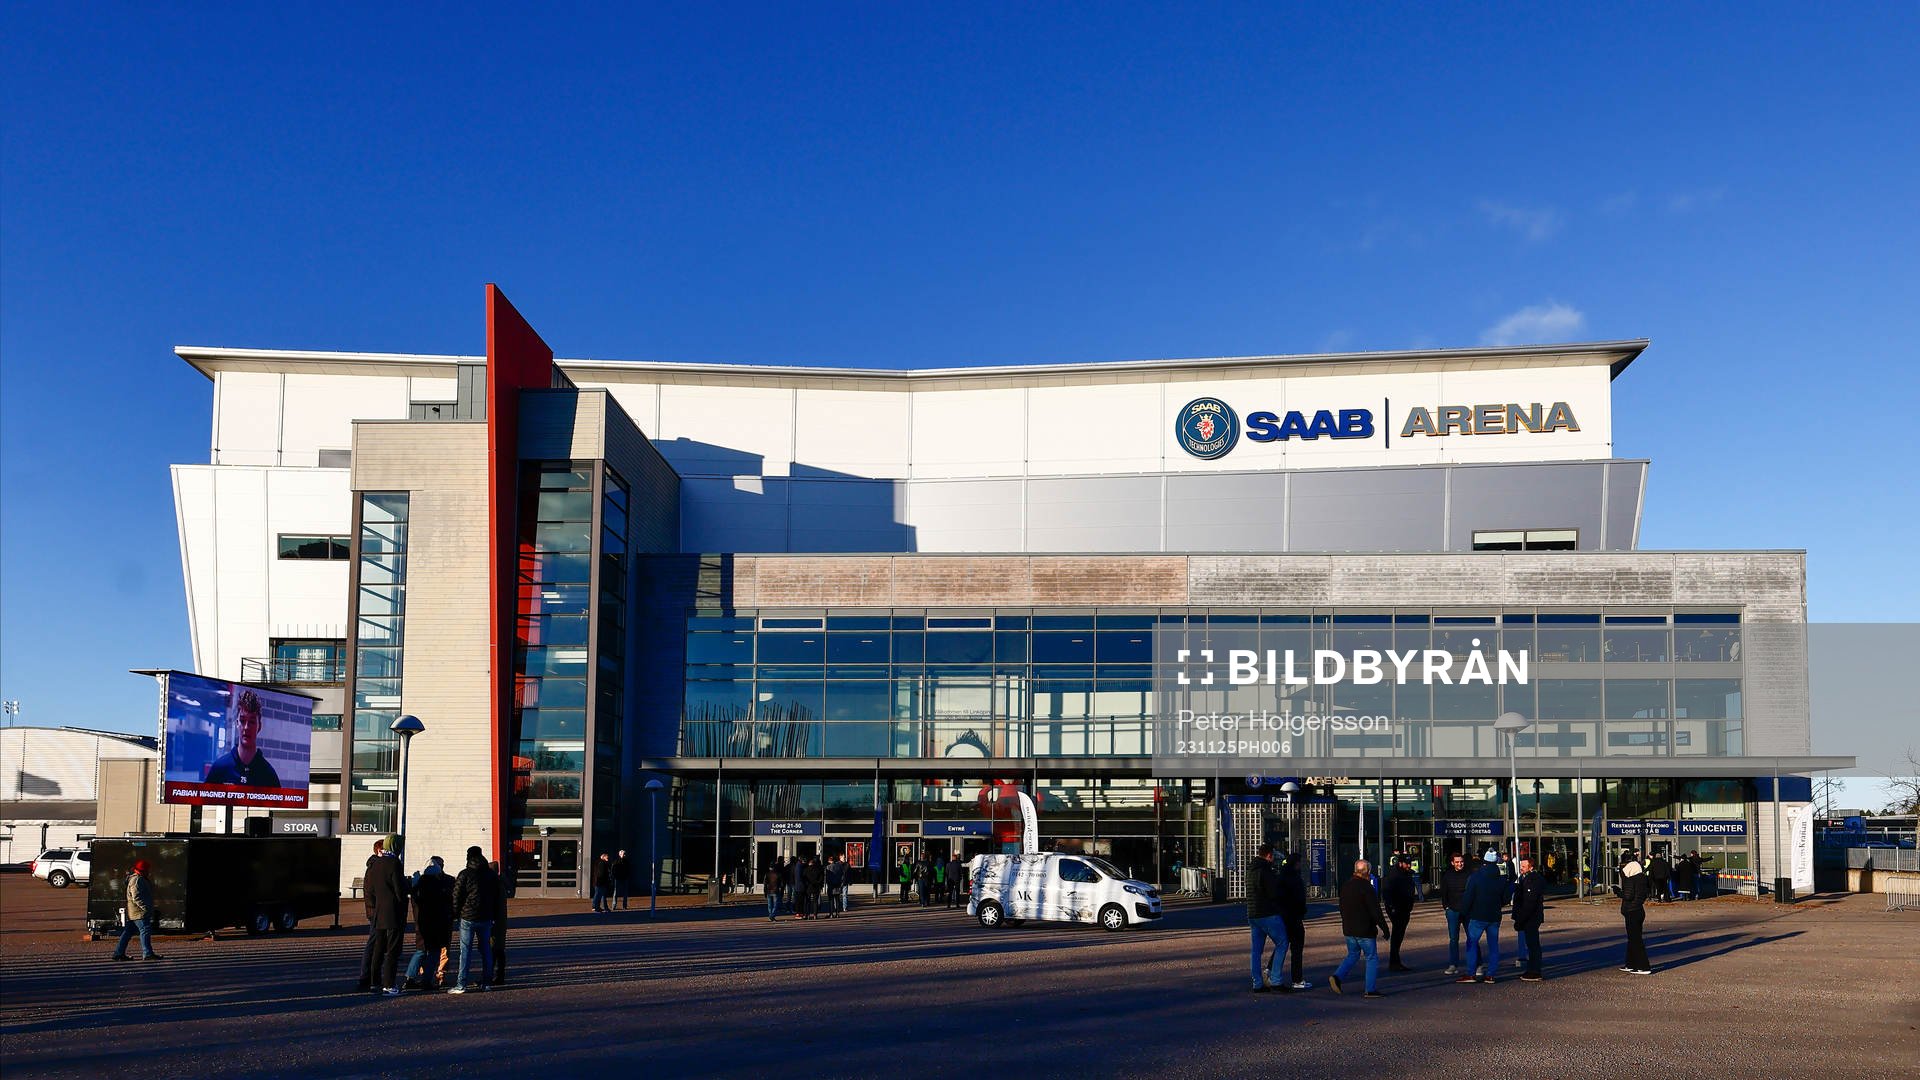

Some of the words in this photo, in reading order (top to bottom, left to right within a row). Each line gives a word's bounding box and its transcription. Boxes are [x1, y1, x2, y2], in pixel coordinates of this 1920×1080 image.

[1191, 403, 1221, 414] SAAB
[1246, 409, 1374, 441] SAAB
[1400, 402, 1581, 438] ARENA
[1188, 437, 1225, 453] TECHNOLOGIES
[1304, 776, 1350, 785] ARENA
[172, 788, 198, 797] FABIAN
[199, 790, 226, 799] WAGNER
[227, 792, 245, 800] EFTER
[246, 793, 284, 802] TORSDAGENS
[283, 823, 319, 832] STORA
